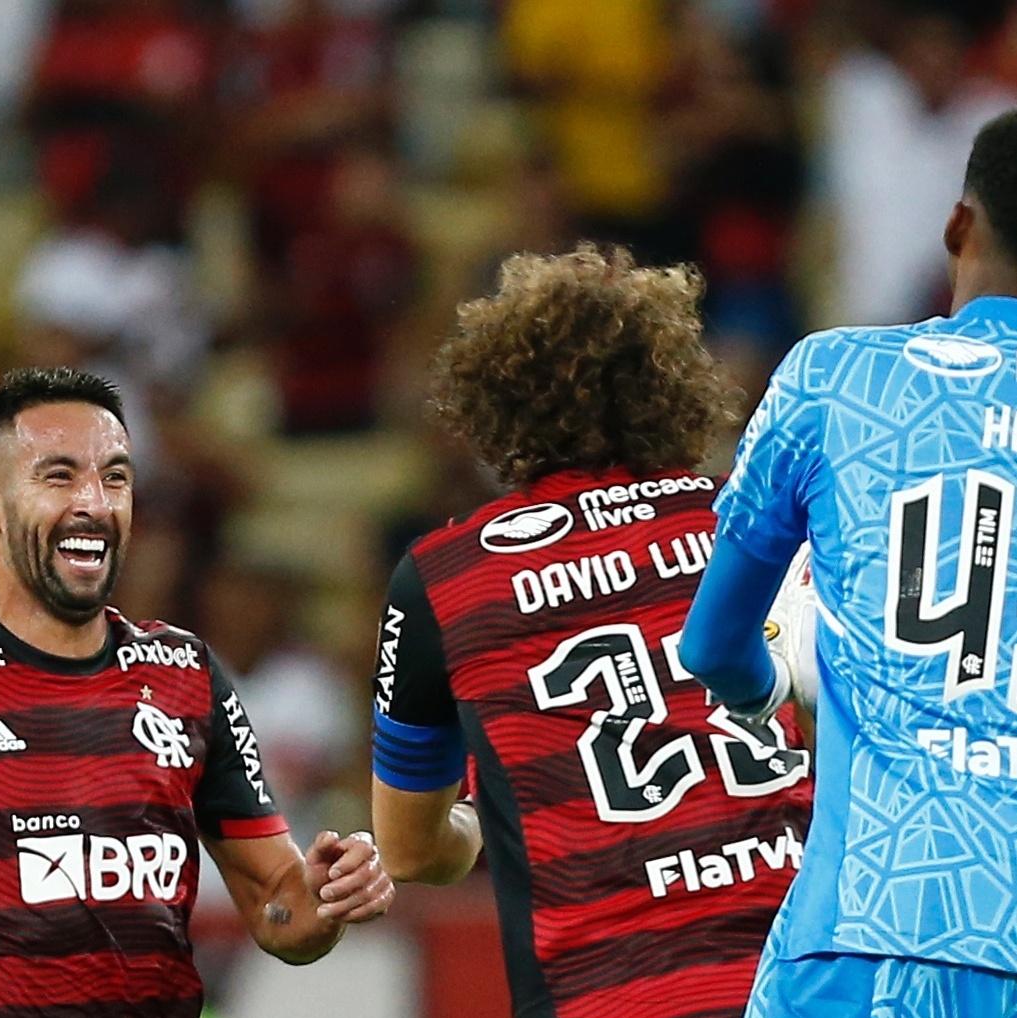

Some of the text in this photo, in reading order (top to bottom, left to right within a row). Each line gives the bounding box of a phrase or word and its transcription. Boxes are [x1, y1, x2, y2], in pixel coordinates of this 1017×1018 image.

[982, 404, 1017, 451] H
[579, 476, 715, 512] mercado
[583, 502, 657, 532] livre
[976, 508, 998, 545] TIM
[511, 530, 718, 614] DAVID LUI
[884, 469, 1017, 704] 4
[116, 640, 201, 672] pixbet
[614, 651, 640, 688] TIM
[222, 691, 273, 805] HAVAN
[917, 727, 1017, 779] FlaT
[12, 814, 81, 832] banco
[89, 833, 188, 901] BRB
